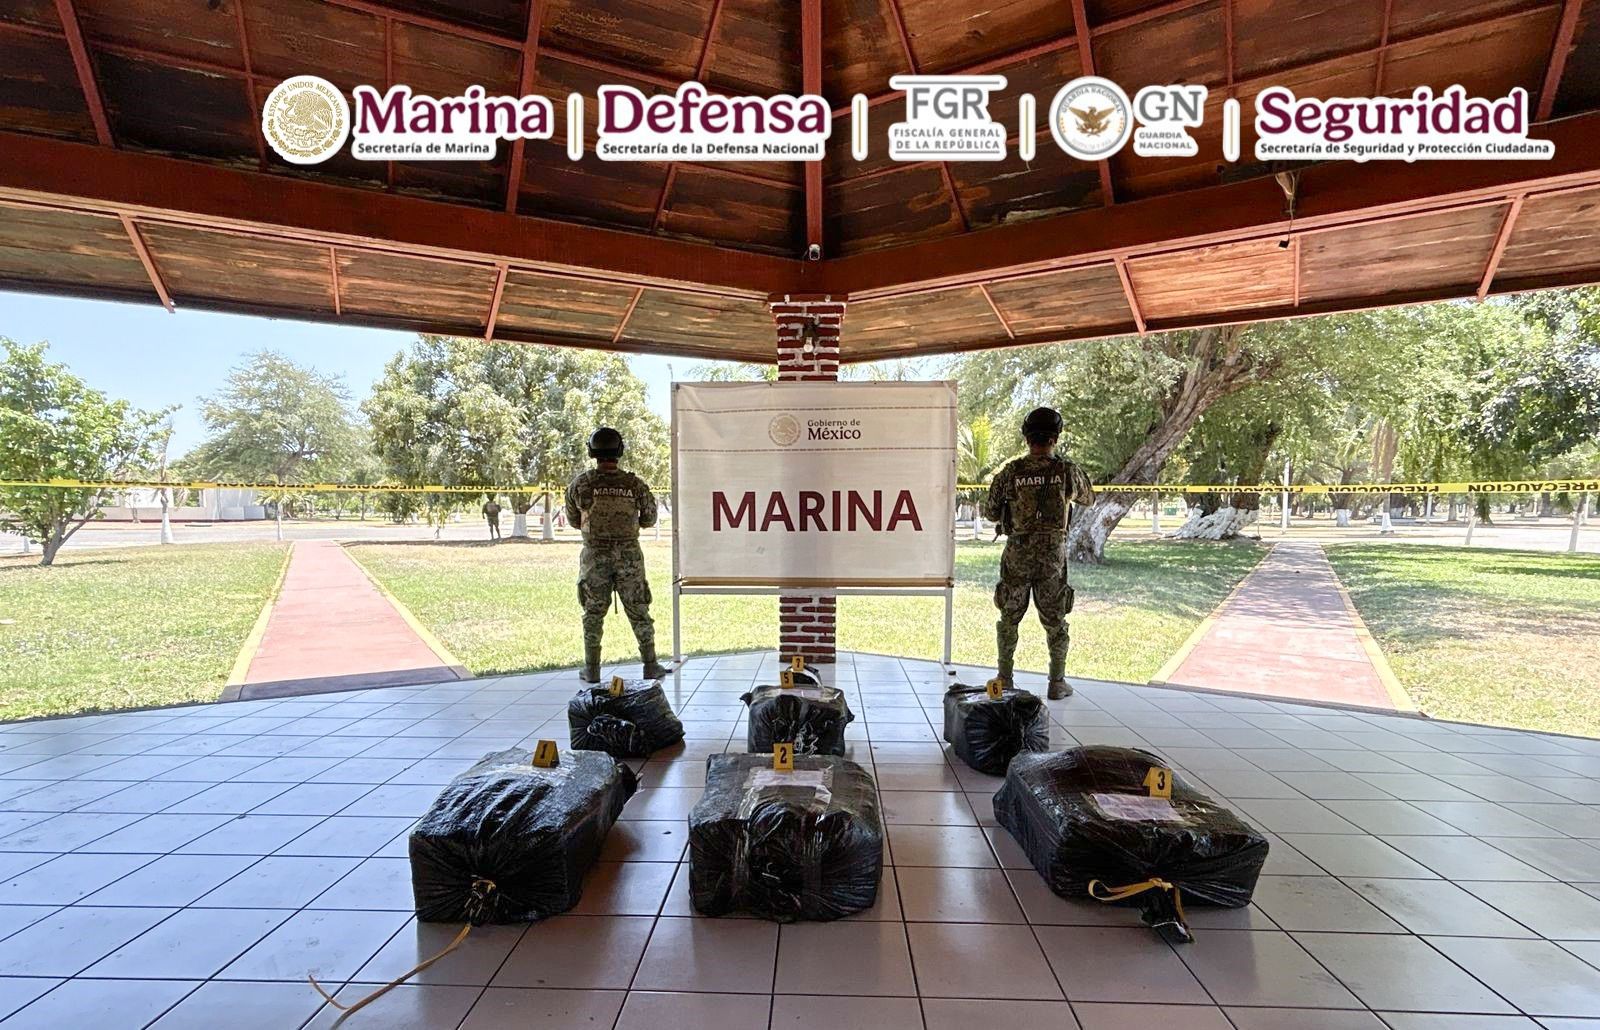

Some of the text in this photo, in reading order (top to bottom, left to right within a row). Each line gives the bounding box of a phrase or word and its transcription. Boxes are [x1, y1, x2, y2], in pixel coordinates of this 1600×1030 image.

[807, 418, 861, 427] Gobierno de
[807, 426, 861, 441] México
[593, 487, 634, 498] MARINA
[1468, 482, 1599, 492] PRECAUCION
[712, 490, 923, 532] MARINA
[796, 658, 801, 668] 7
[783, 673, 790, 684] 5
[992, 682, 999, 695] 6
[780, 746, 787, 764] 2
[1157, 771, 1165, 790] 3
